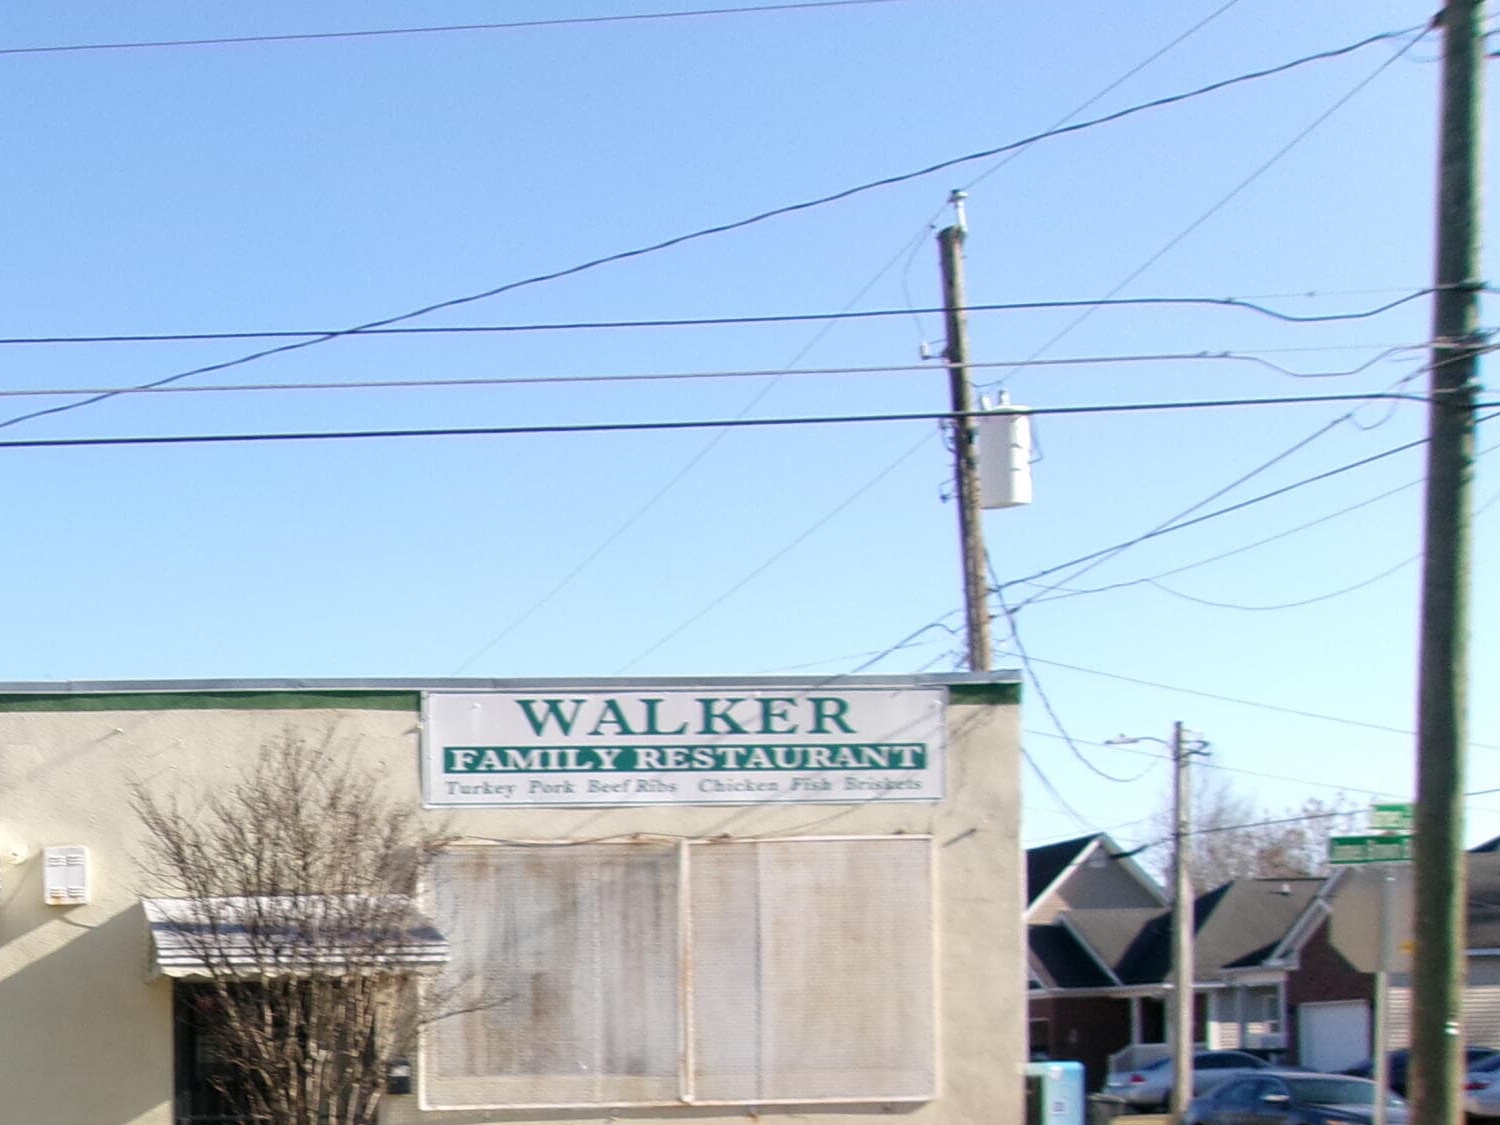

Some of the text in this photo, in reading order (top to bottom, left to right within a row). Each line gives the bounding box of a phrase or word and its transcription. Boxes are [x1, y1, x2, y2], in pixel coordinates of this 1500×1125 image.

[514, 695, 857, 738] WALKER
[452, 744, 924, 771] FAMILY RESTAURANT
[446, 780, 516, 798] Turkey
[528, 779, 575, 794] Pork
[588, 778, 632, 793] Beef
[635, 778, 678, 793] Ribs
[699, 777, 779, 793] Chicken
[790, 776, 832, 791] Fish
